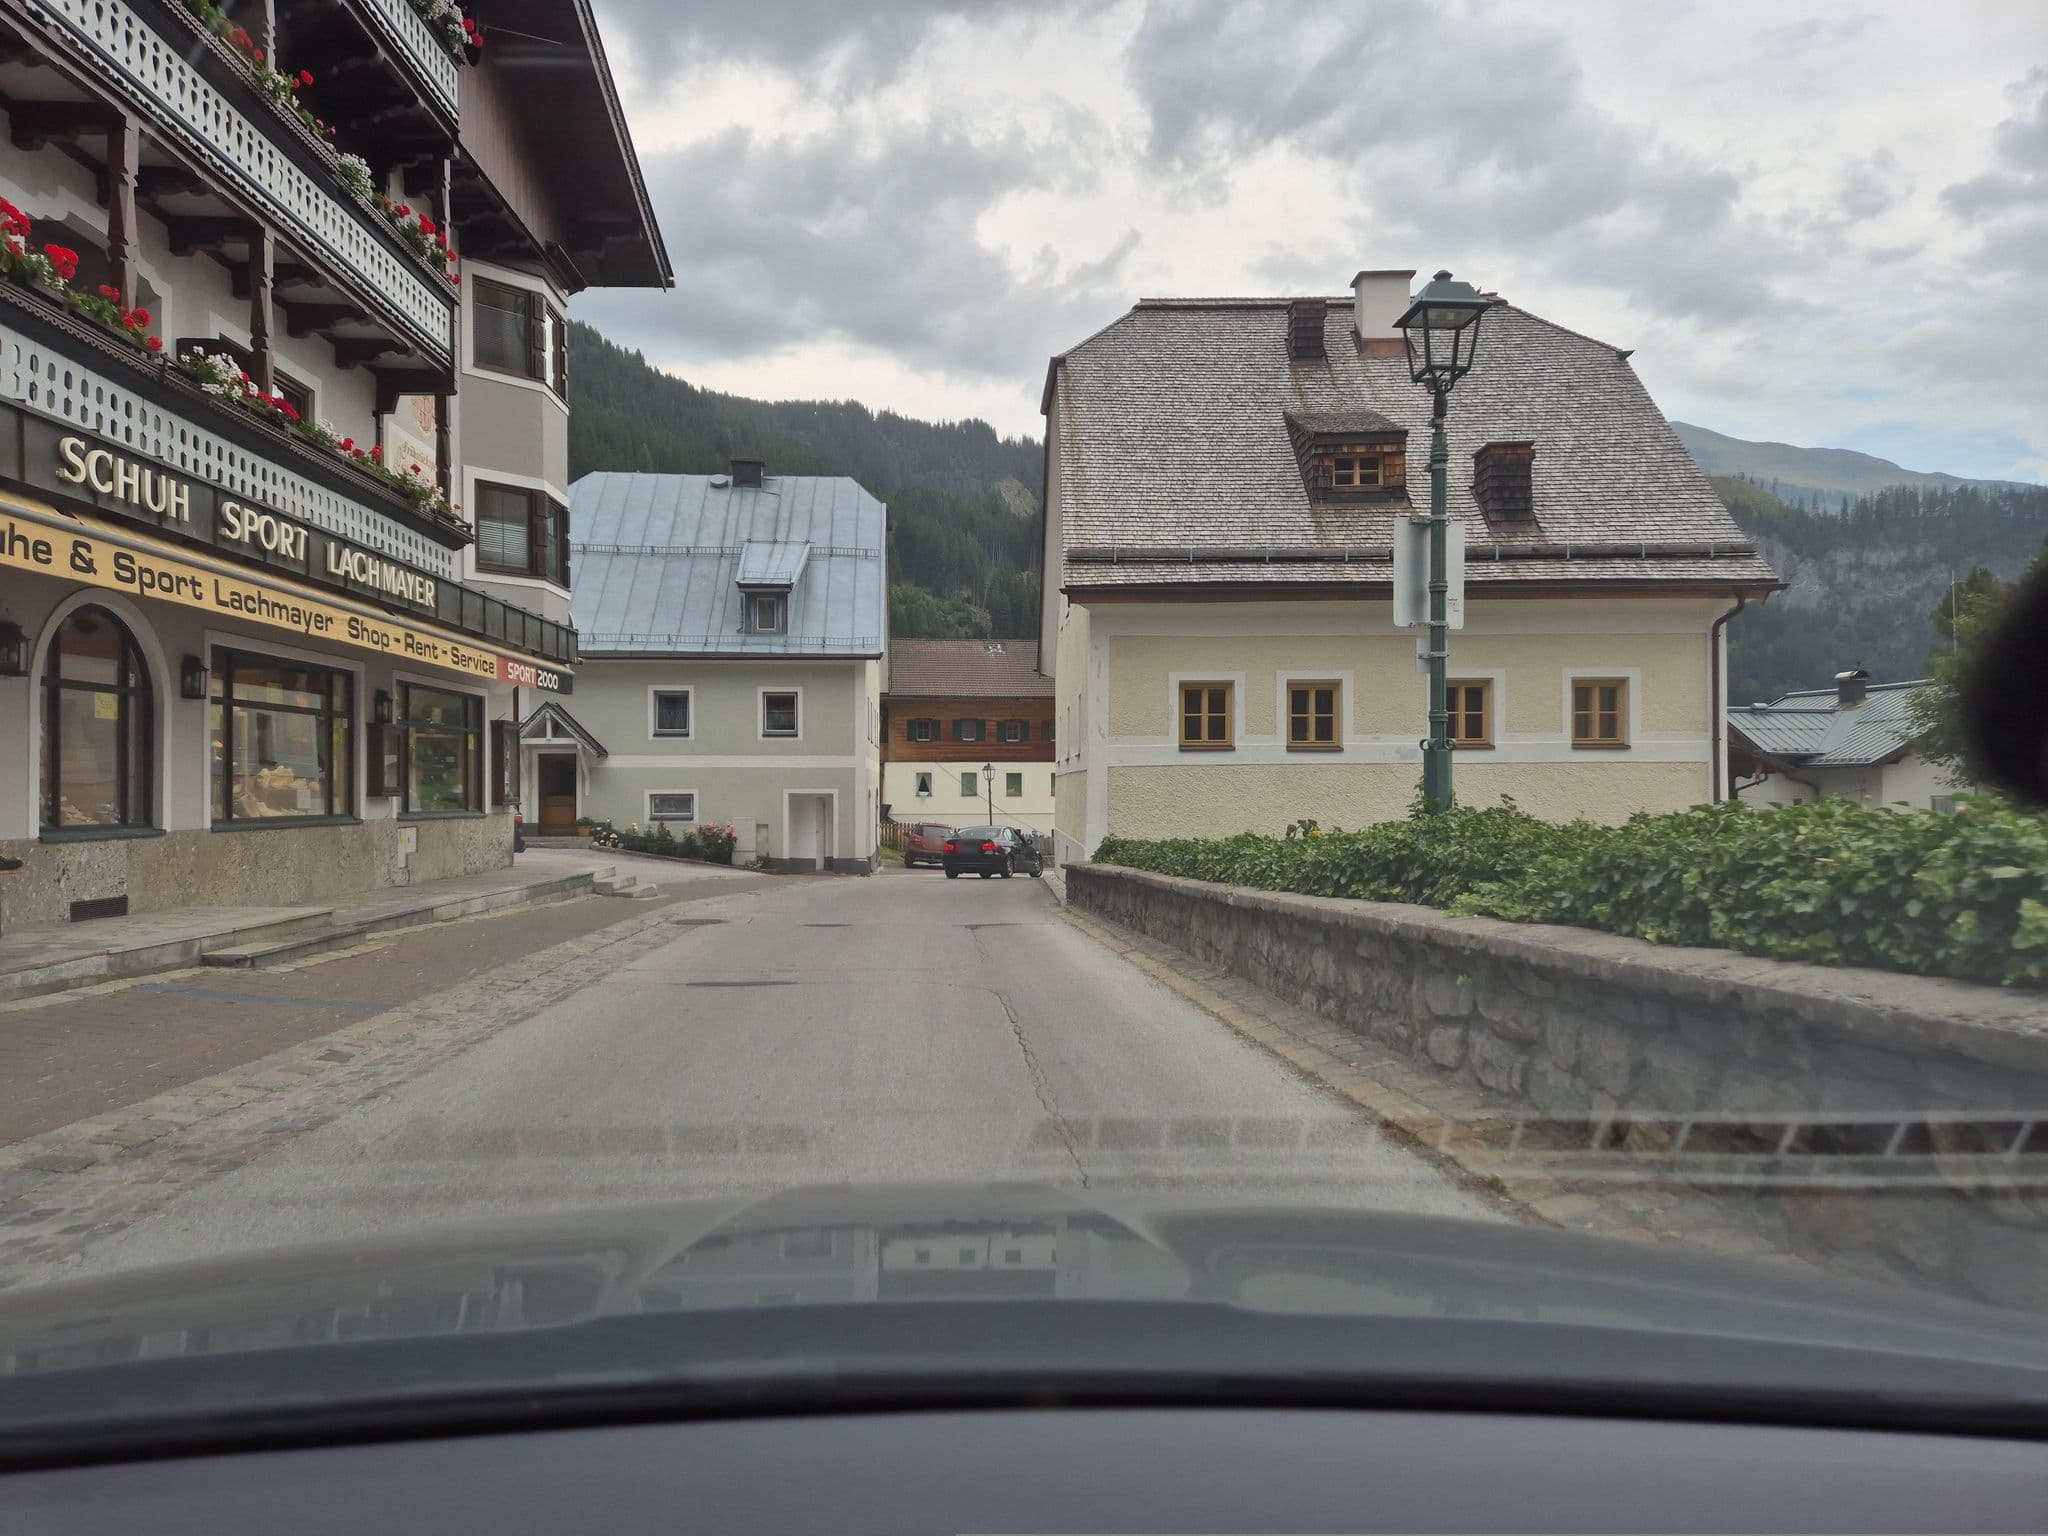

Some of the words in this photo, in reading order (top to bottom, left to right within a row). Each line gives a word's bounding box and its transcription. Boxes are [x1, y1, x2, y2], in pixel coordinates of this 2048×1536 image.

[56, 437, 190, 522] SCHUH
[219, 501, 309, 561] SPORT
[326, 541, 435, 608] LACHMAYER
[70, 540, 97, 575] &
[113, 551, 203, 600] Sport
[214, 578, 334, 634] Lachmayer
[347, 616, 390, 650] Shop
[404, 632, 438, 660] Rent
[450, 647, 495, 674] Service
[507, 661, 536, 688] SPORT
[537, 669, 559, 690] 2000
